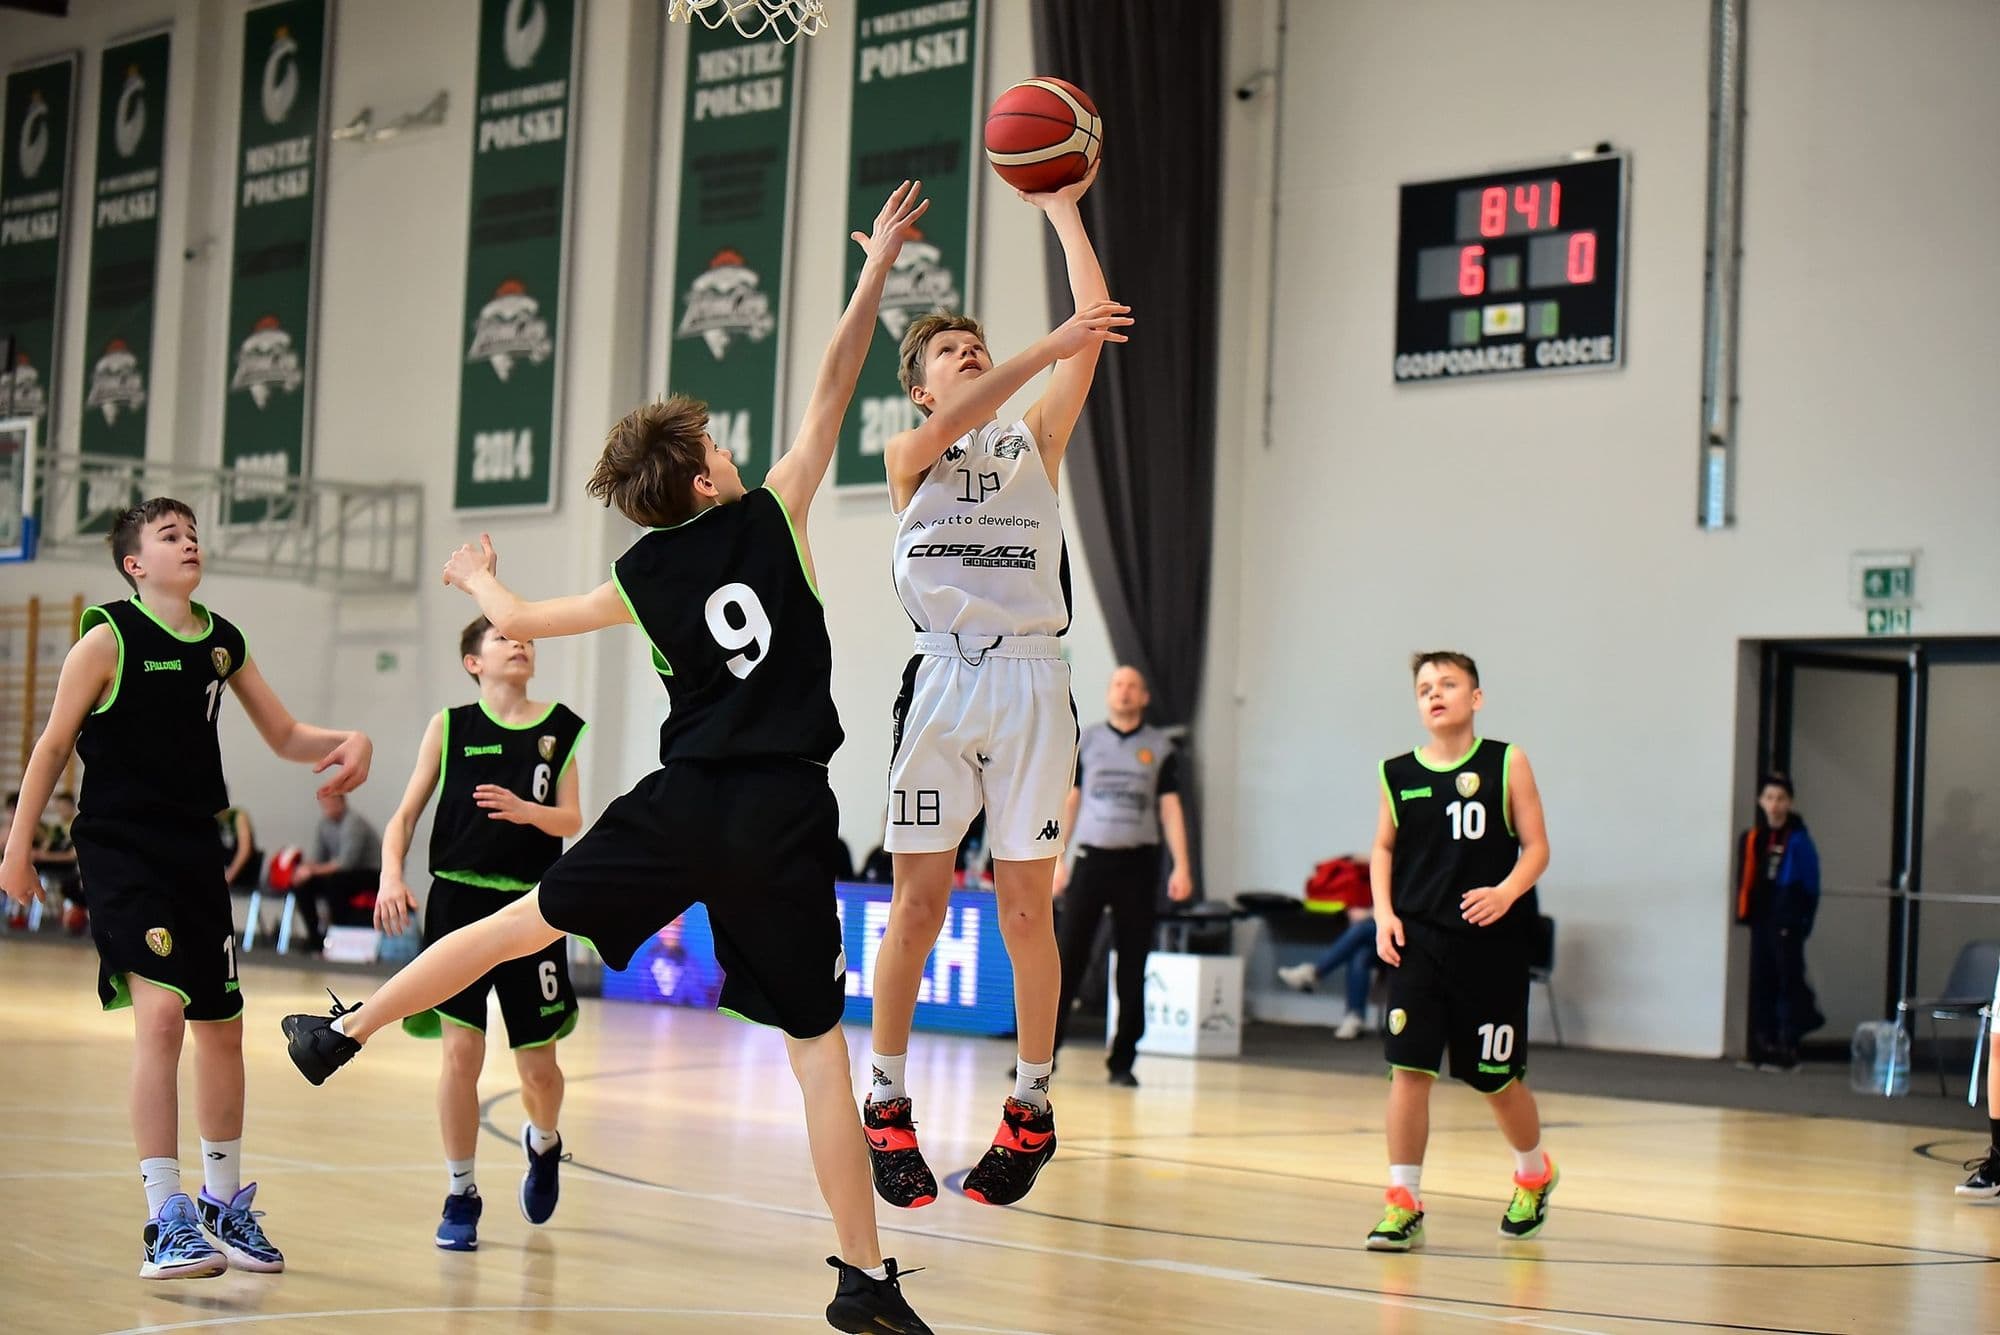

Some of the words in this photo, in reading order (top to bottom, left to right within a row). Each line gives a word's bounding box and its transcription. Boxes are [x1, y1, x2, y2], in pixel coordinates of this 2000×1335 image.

[696, 42, 786, 83] MISTRZ
[861, 28, 968, 83] POLSKI
[694, 77, 782, 121] POLSKI
[480, 107, 564, 153] POLSKI
[243, 167, 309, 208] POLSKI
[1458, 245, 1485, 296] 6
[1566, 231, 1596, 283] 0
[1395, 344, 1525, 379] GOSPODARZE
[978, 514, 1040, 529] deweloper
[907, 544, 1037, 560] COSSACK
[963, 557, 1035, 570] CONCRETE
[705, 583, 772, 680] 9
[144, 660, 182, 672] SPALDING
[533, 763, 551, 803] 6
[893, 790, 940, 825] 18
[1446, 801, 1486, 840] 10
[539, 960, 558, 1001] 6
[1478, 1023, 1514, 1062] 10
